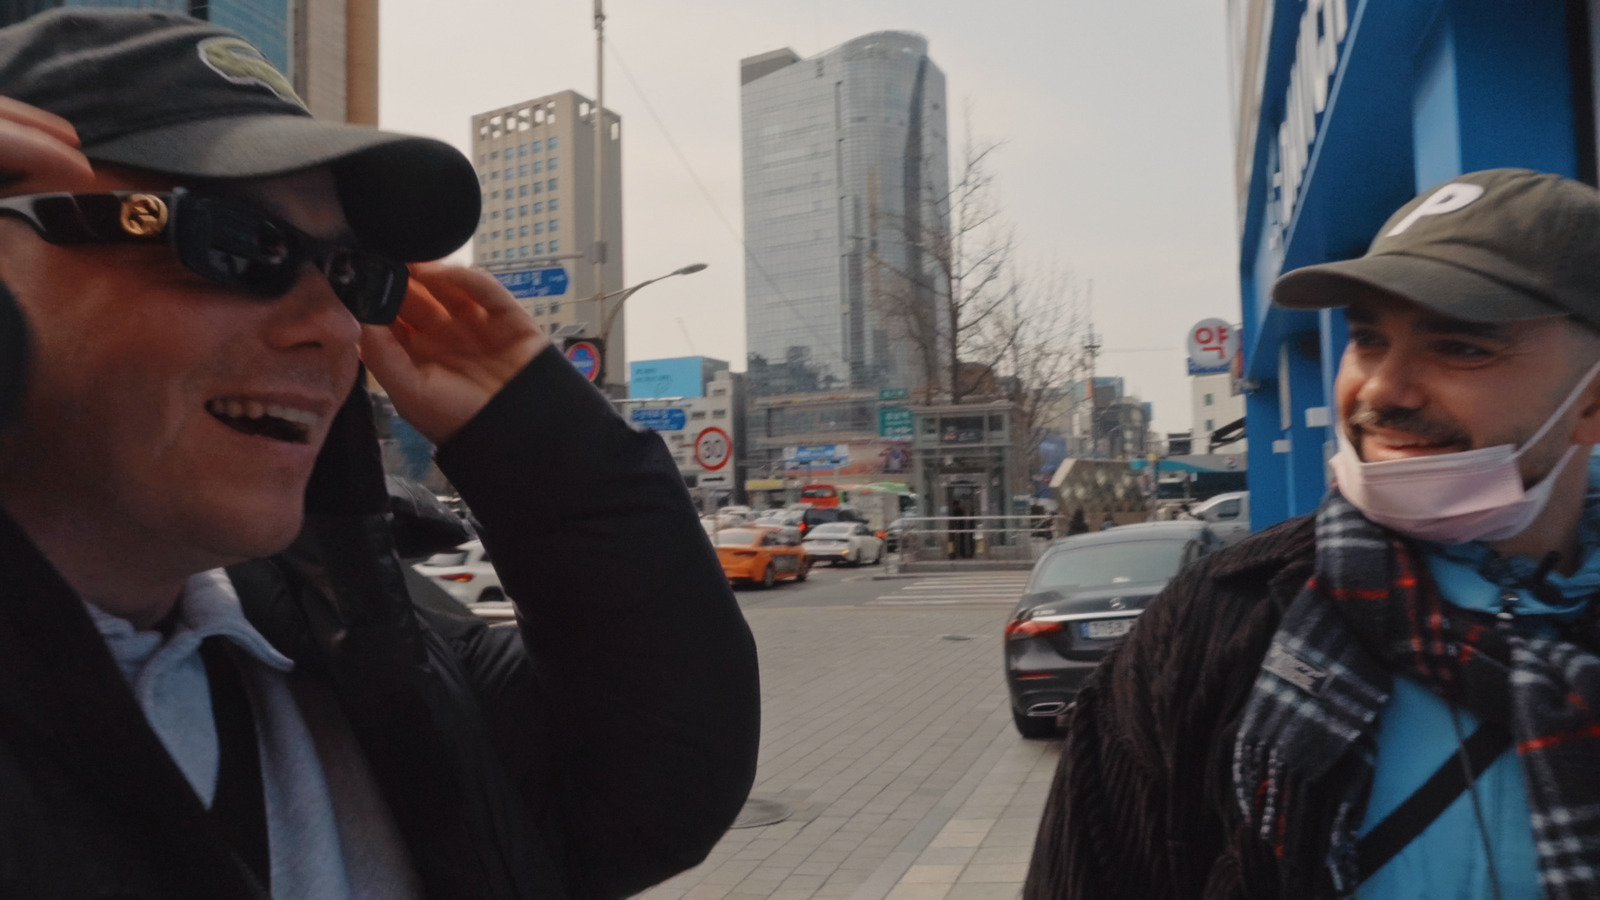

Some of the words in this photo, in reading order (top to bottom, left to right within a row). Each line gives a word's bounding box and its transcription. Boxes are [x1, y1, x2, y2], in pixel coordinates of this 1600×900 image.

[1384, 182, 1484, 238] P
[1194, 325, 1228, 361] 약
[702, 439, 725, 460] 30
